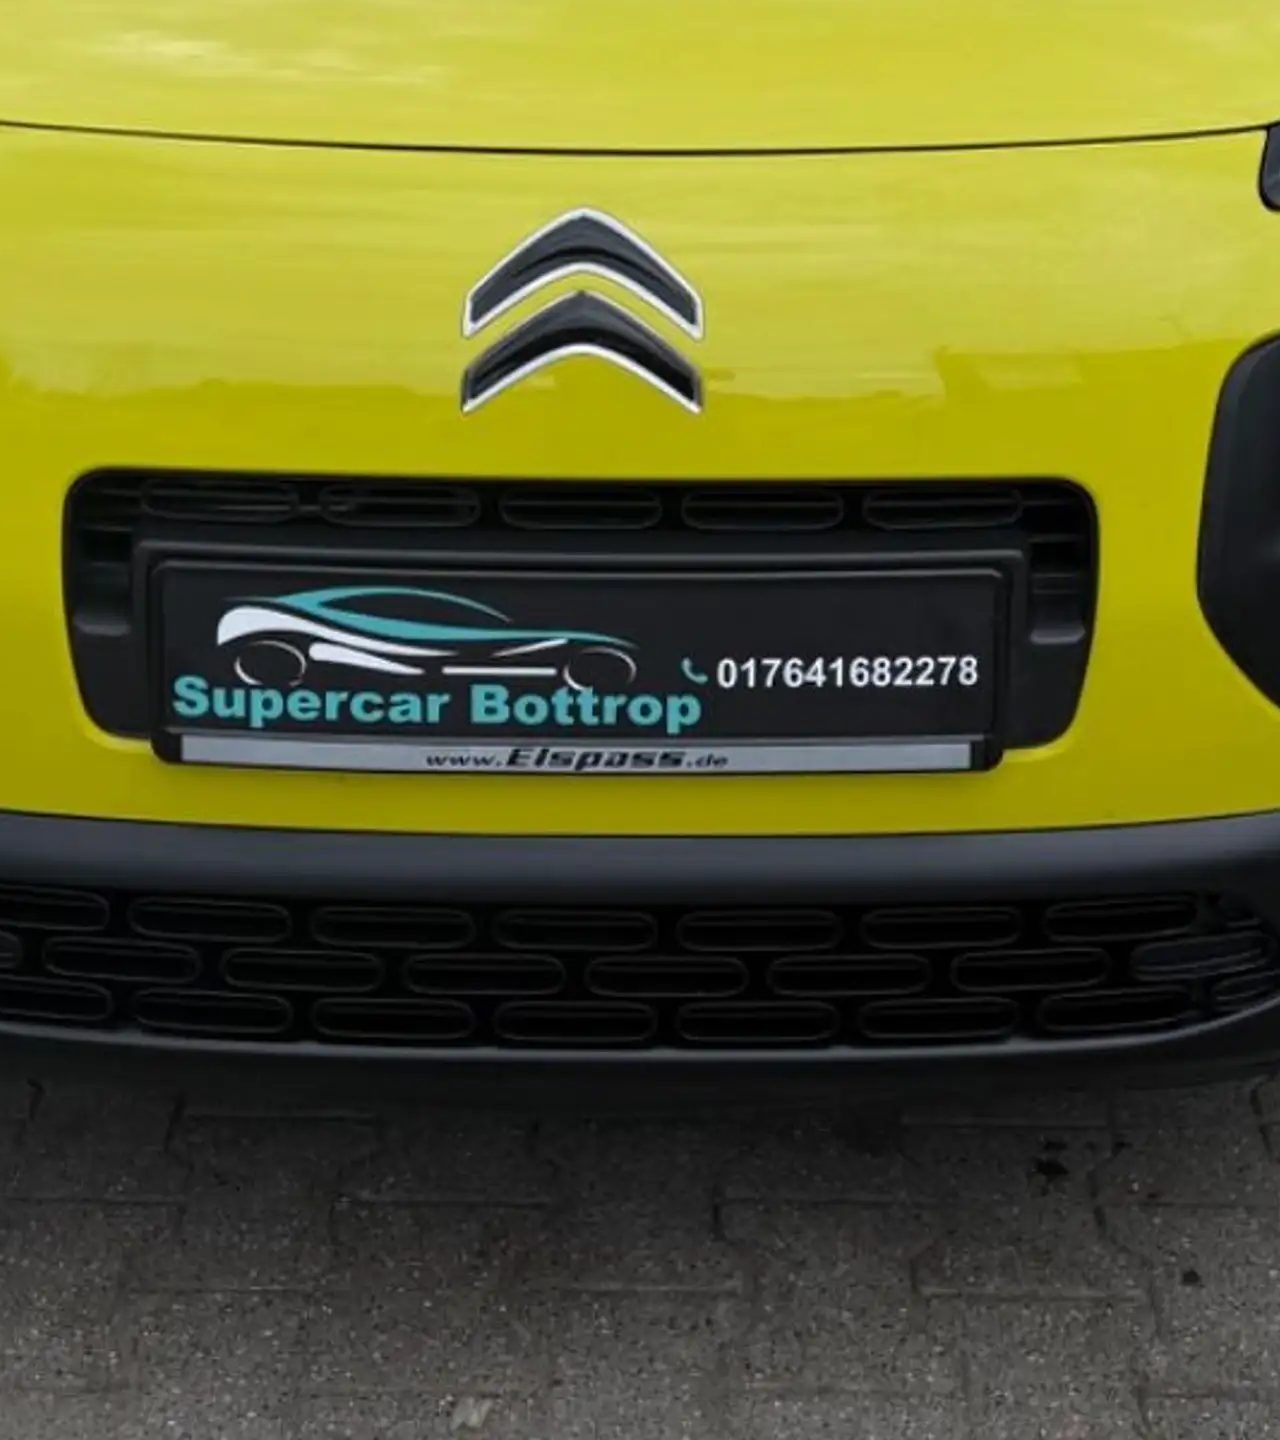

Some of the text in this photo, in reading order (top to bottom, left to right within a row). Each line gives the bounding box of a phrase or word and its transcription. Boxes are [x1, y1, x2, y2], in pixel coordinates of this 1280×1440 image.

[716, 654, 979, 689] 017641682278
[172, 675, 702, 735] Supercar Bottrop
[425, 747, 730, 772] www.Elspass.de
